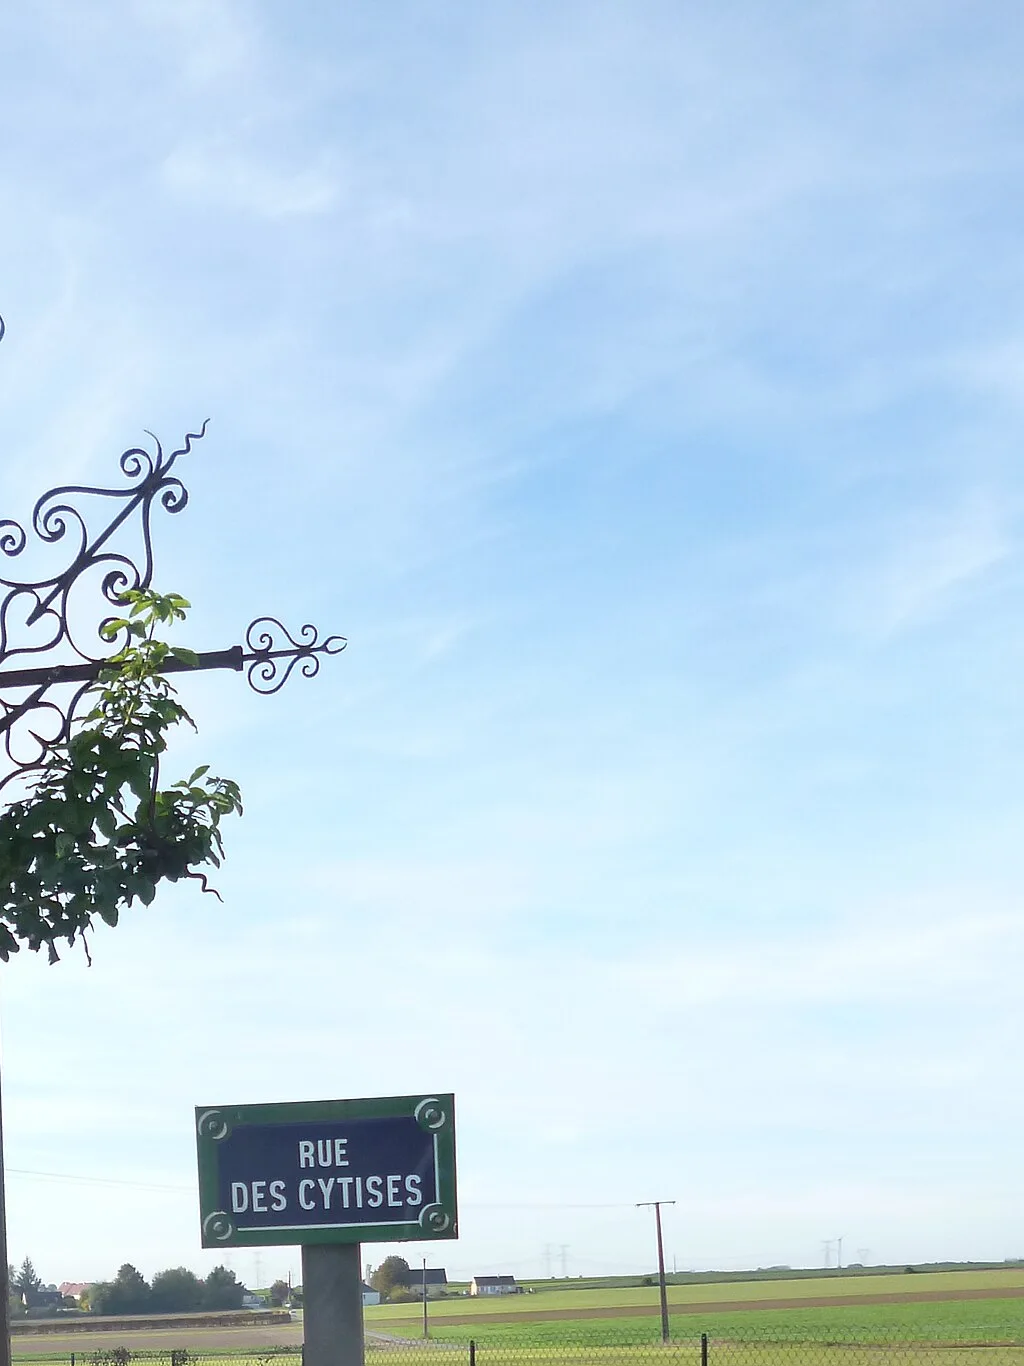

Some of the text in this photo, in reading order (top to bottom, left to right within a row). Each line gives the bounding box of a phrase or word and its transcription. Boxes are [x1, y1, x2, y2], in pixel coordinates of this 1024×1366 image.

[299, 1139, 349, 1168] RUE
[231, 1174, 422, 1213] DES CYTISES
